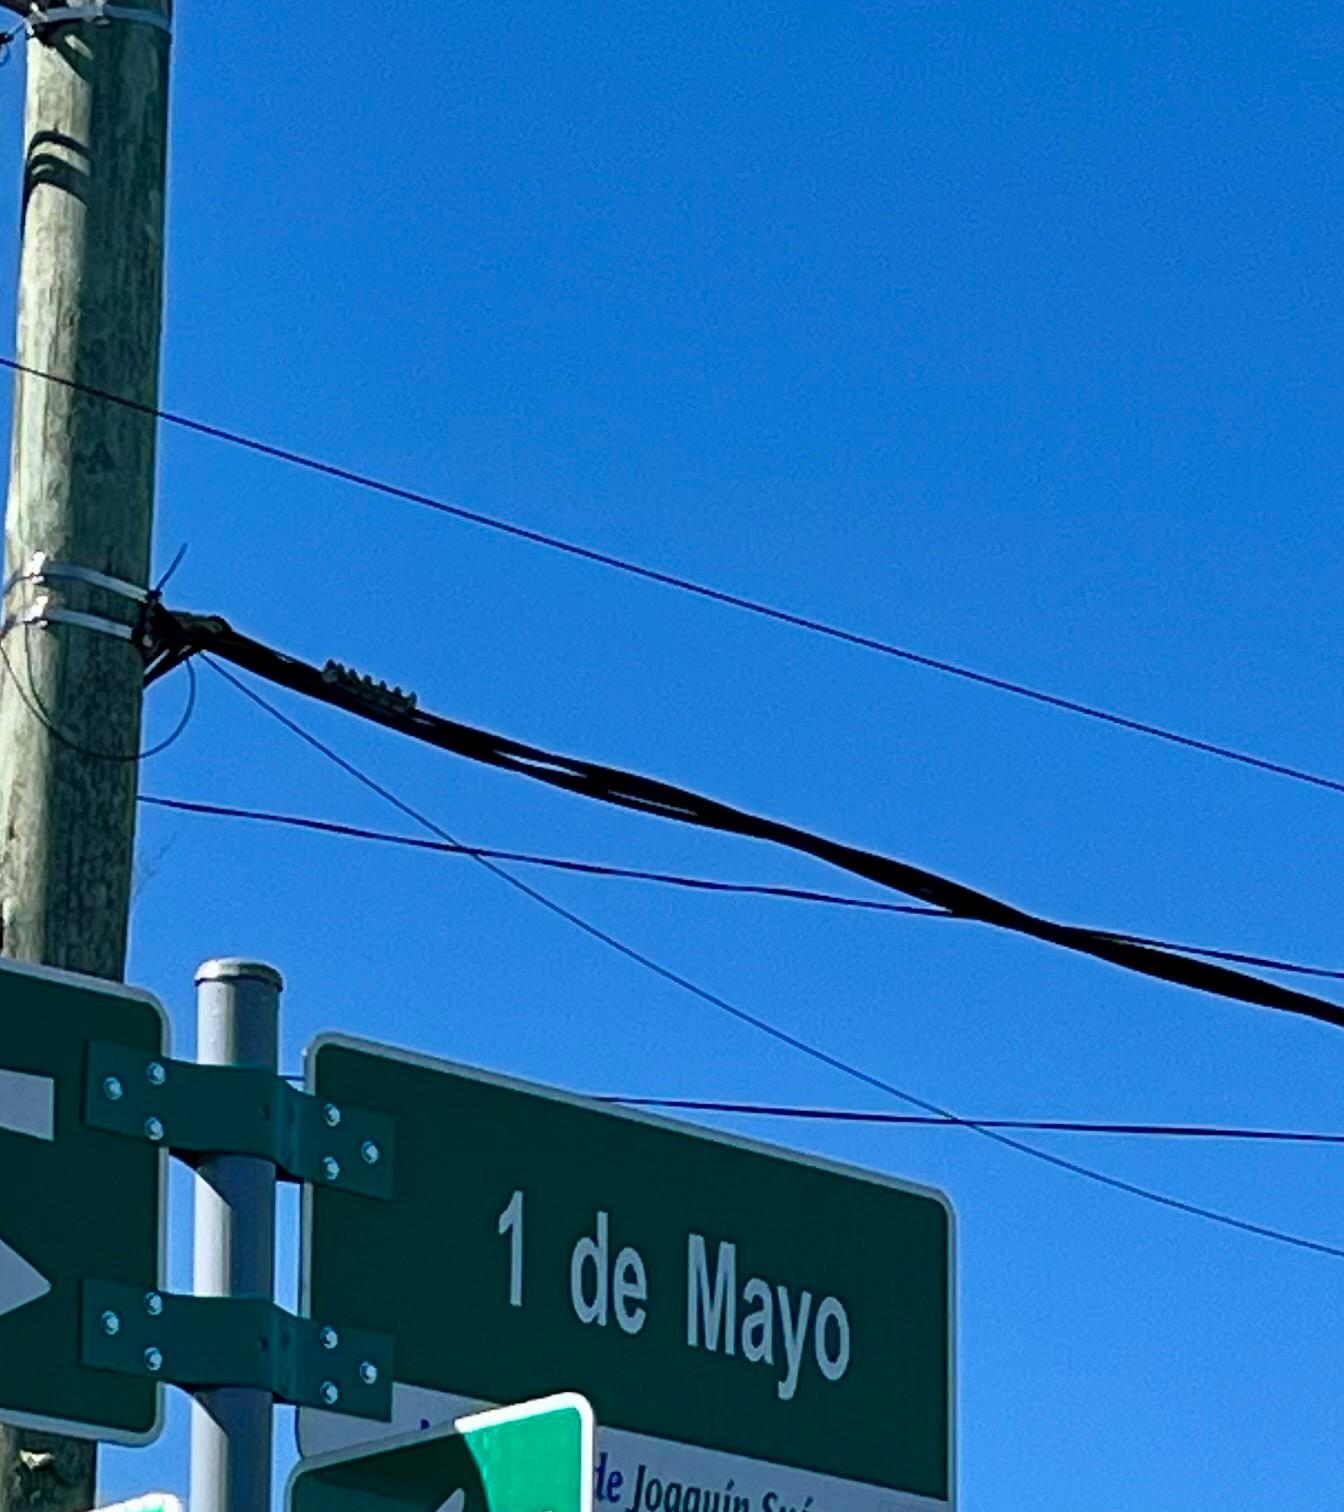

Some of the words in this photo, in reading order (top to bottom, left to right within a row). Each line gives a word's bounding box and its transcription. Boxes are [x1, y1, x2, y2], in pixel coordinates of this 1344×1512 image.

[498, 1190, 524, 1307] 1
[570, 1210, 647, 1335] de
[687, 1233, 851, 1401] Mayo
